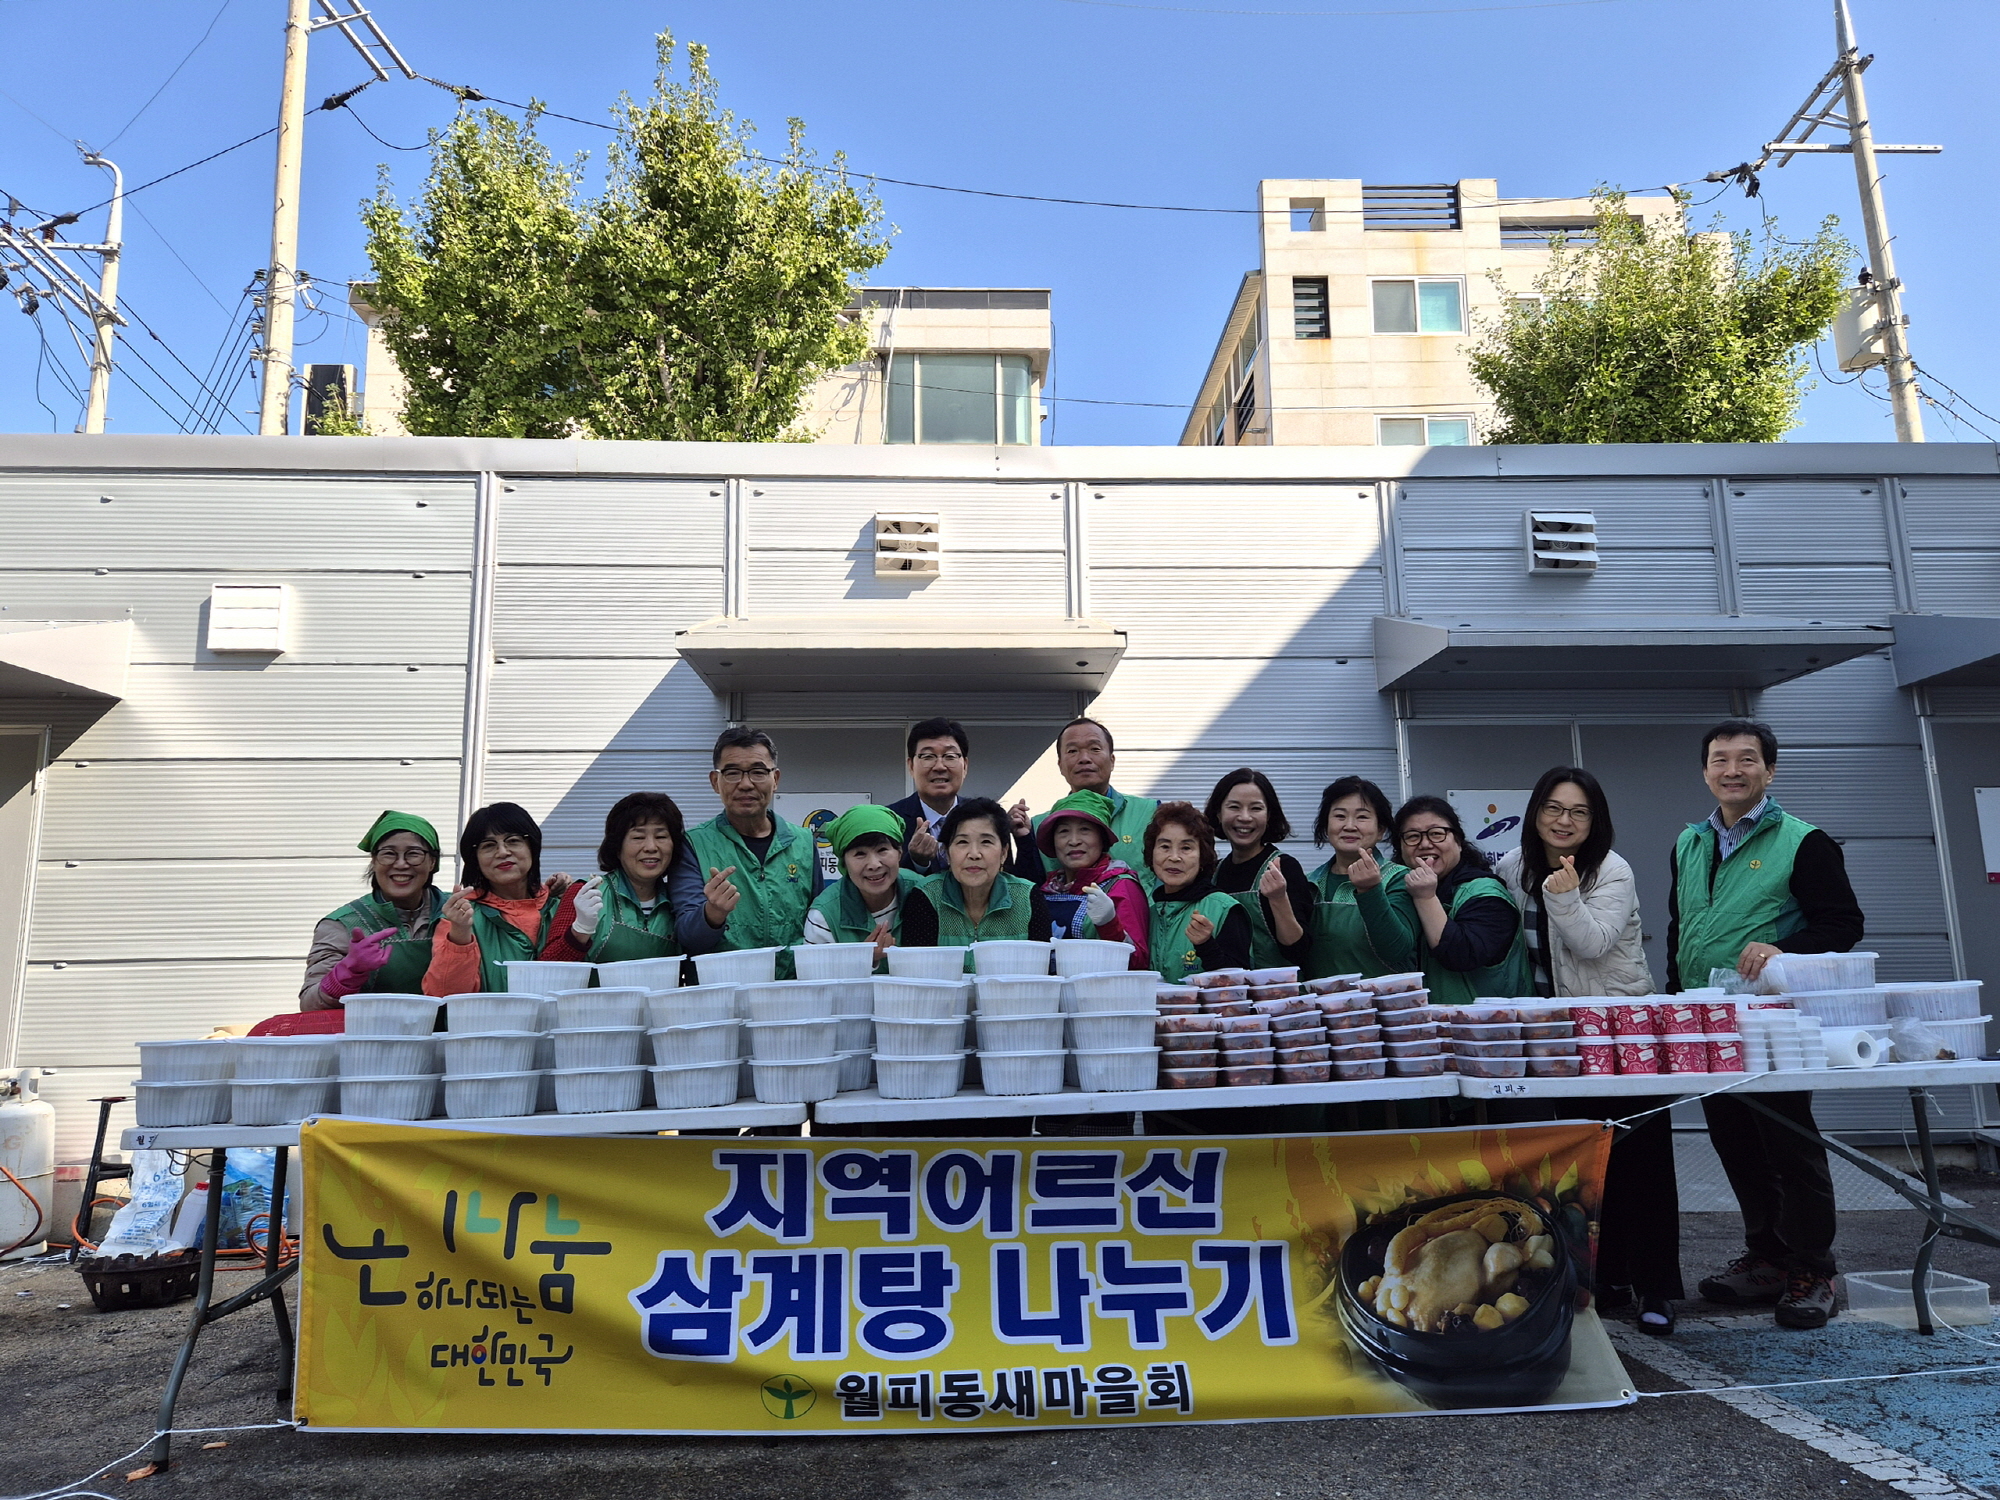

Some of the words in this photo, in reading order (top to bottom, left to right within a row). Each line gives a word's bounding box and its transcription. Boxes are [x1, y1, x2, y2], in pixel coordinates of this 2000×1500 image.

[707, 1150, 1225, 1241] 지역어르신
[415, 1271, 536, 1324] 하나되는
[632, 1248, 957, 1358] 삼계탕
[993, 1242, 1296, 1348] 나누기
[431, 1325, 573, 1386] 대한민국
[836, 1363, 1193, 1420] 월피동새마을회
